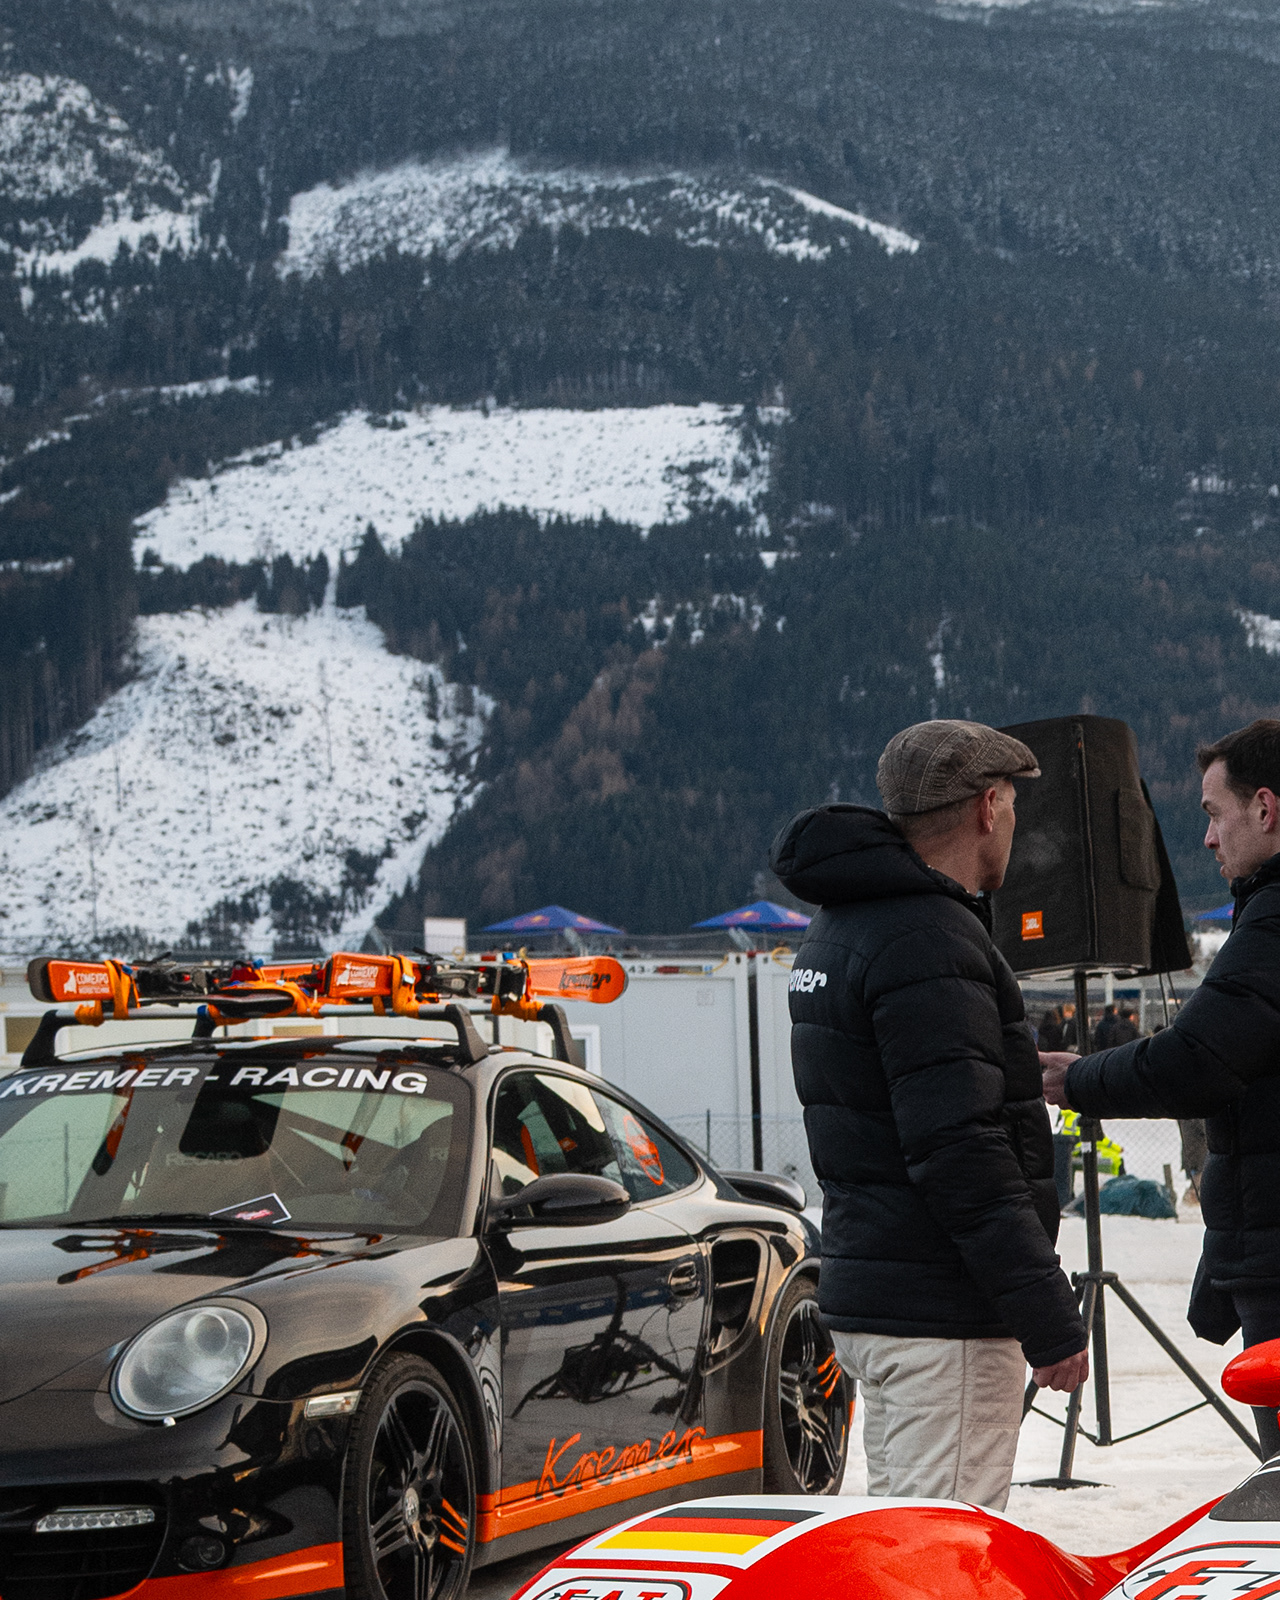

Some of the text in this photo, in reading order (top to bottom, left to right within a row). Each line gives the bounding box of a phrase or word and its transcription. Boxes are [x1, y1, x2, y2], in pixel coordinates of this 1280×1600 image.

[0, 1067, 200, 1098] KREMER
[230, 1066, 428, 1094] RACING
[534, 1426, 706, 1500] Kremer
